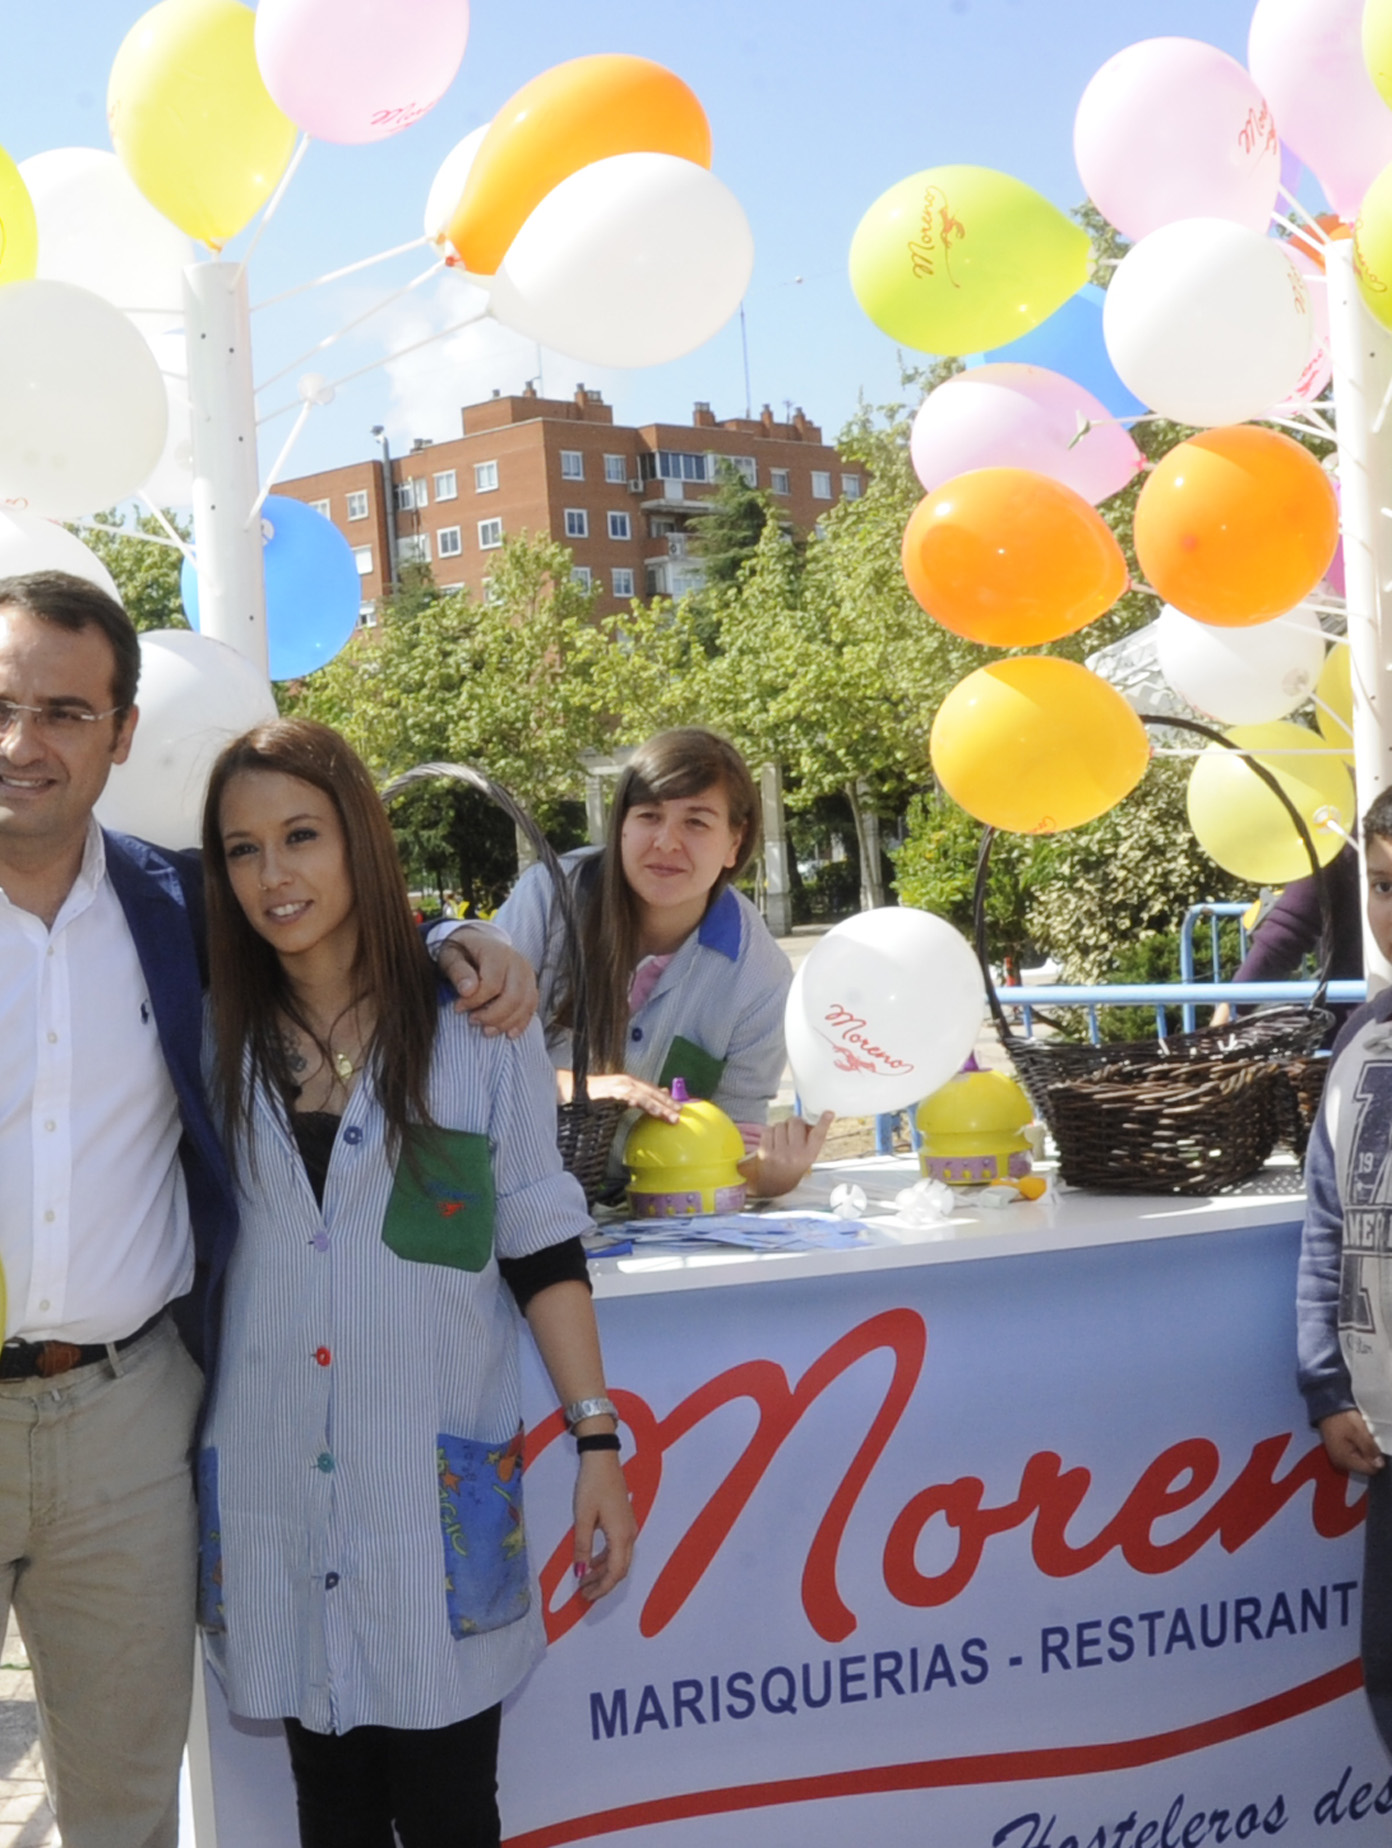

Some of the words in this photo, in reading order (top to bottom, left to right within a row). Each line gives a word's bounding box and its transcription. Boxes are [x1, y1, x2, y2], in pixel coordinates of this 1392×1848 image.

[908, 188, 939, 279] Moreno
[825, 1004, 911, 1072] Moreno
[1359, 1152, 1374, 1173] 19
[590, 1637, 990, 1742] MARISQUERIAS
[1040, 1581, 1357, 1673] RESTAURANT
